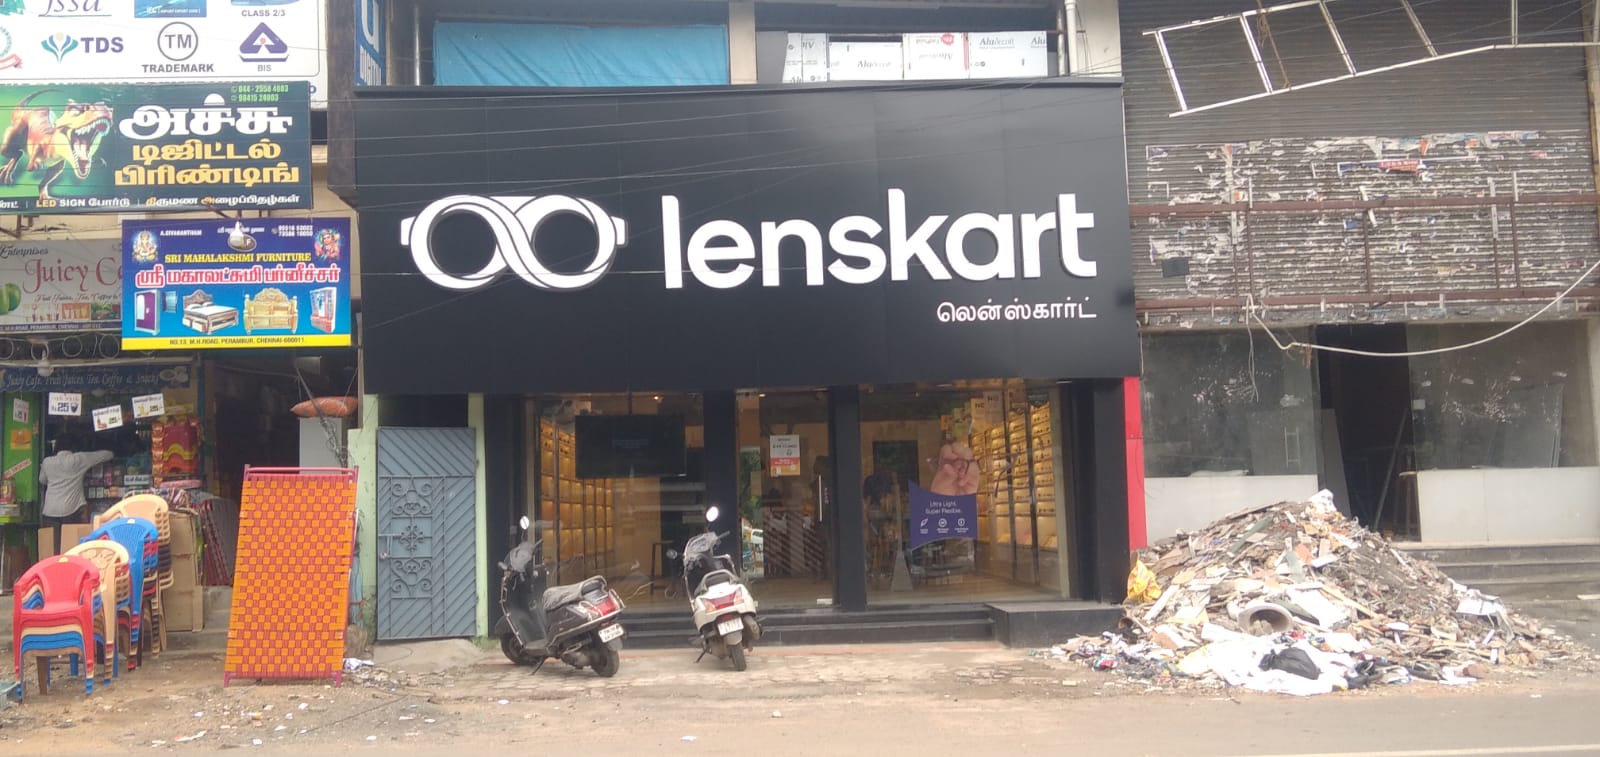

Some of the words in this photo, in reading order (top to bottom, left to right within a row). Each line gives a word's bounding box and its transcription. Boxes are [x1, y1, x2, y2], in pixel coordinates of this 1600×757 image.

[241, 9, 270, 17] CLASS
[272, 9, 286, 17] 2/3
[80, 36, 124, 53] TDS
[164, 34, 192, 49] TM
[141, 63, 214, 73] TRADEMARK
[257, 64, 272, 72] BIS
[119, 93, 293, 140] அச்சு
[132, 138, 282, 166] டிஜிட்டல்
[114, 162, 300, 188] பிரிண்டிங்
[36, 199, 57, 208] LED
[59, 198, 86, 207] SIGN
[661, 187, 1098, 290] lenskart
[164, 253, 181, 263] SRI
[183, 253, 254, 263] MAHALAKSHMI
[256, 252, 312, 262] FURNITURE
[22, 258, 89, 294] Juicy
[135, 263, 165, 288] ஸ்ரீ
[166, 264, 262, 285] மகாலட்சுமி
[263, 262, 341, 283] பர்னீச்சர்
[936, 296, 1097, 323] லென்ஸ்கார்ட்
[57, 402, 70, 413] 25
[925, 507, 941, 515] Super
[929, 500, 942, 508] Ultra
